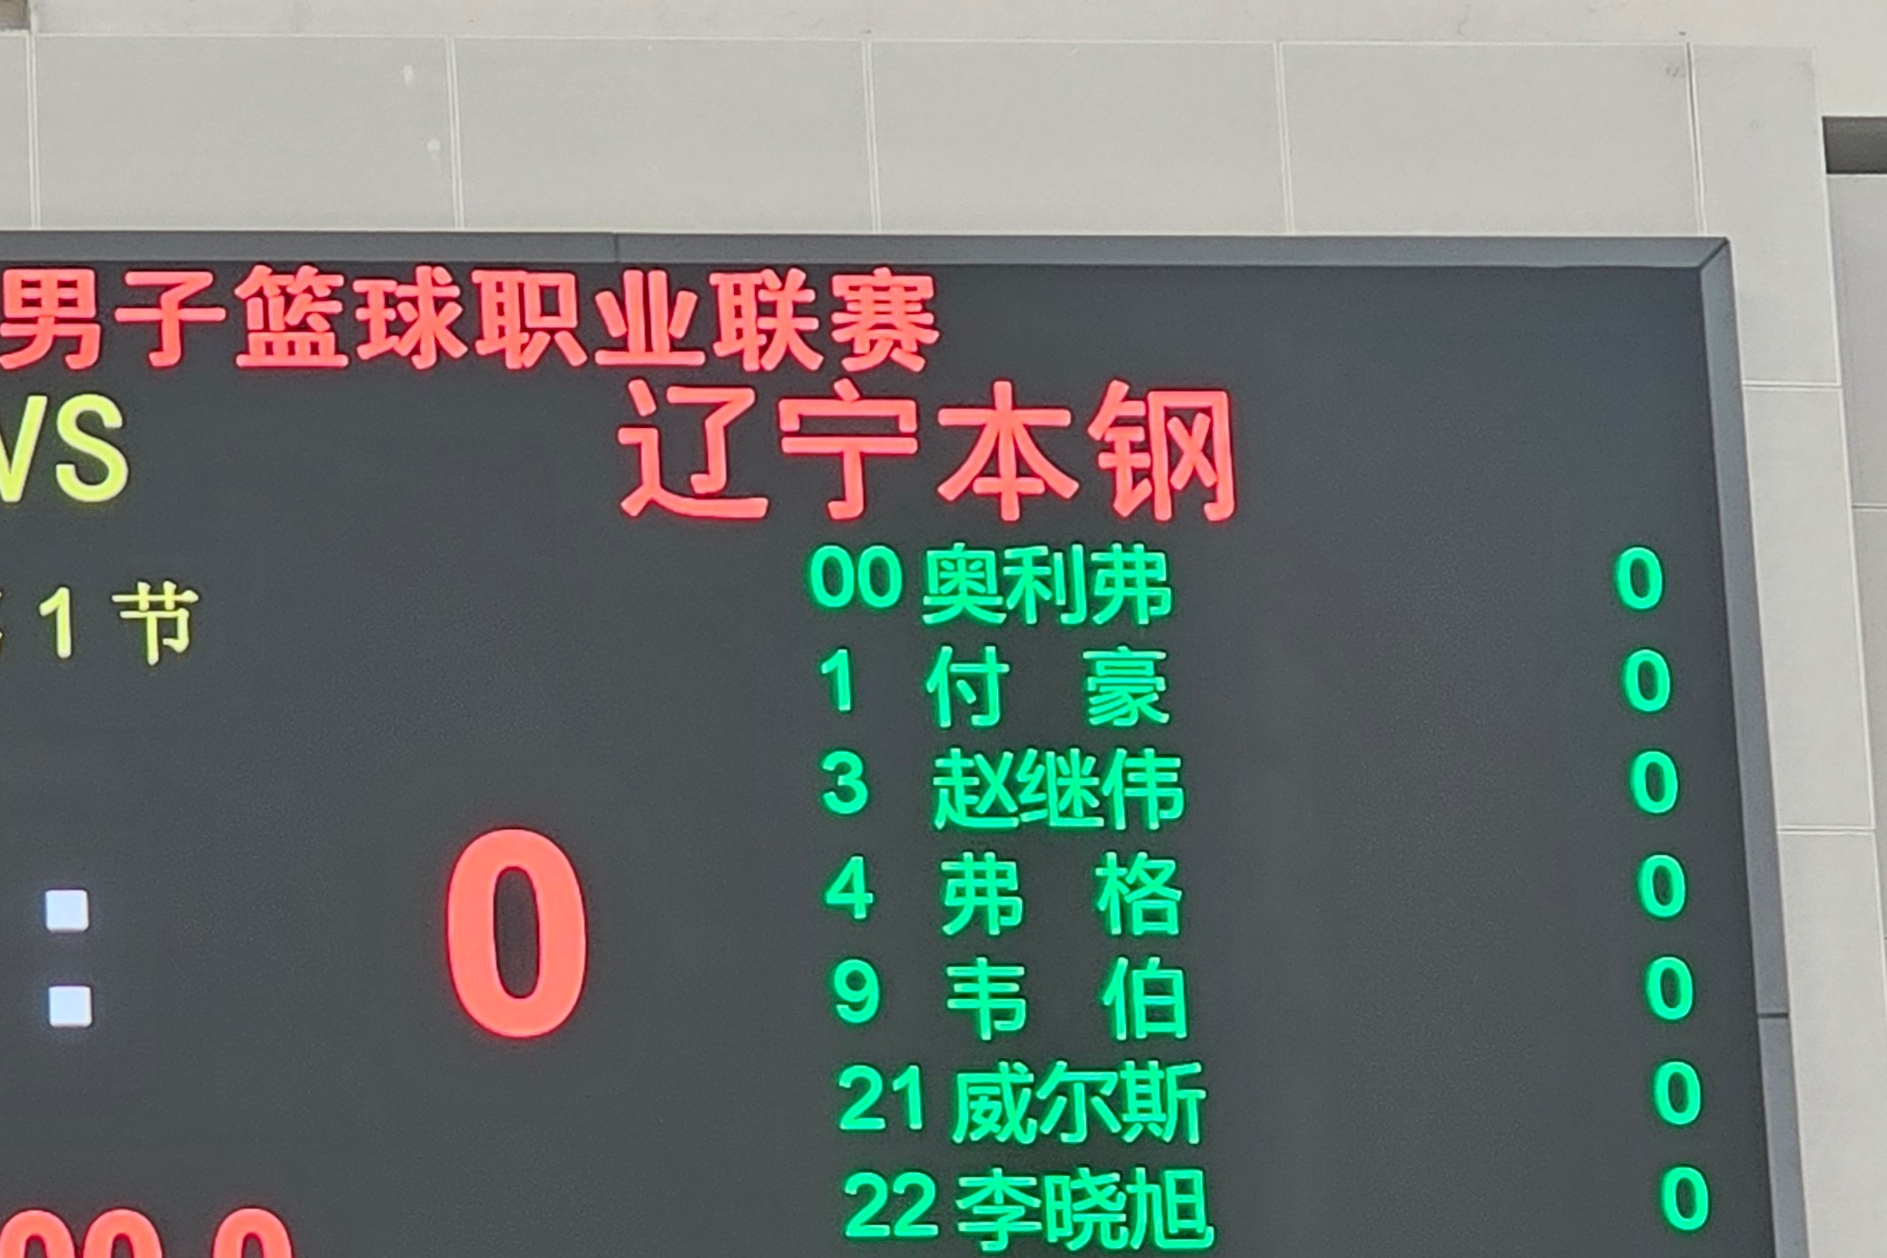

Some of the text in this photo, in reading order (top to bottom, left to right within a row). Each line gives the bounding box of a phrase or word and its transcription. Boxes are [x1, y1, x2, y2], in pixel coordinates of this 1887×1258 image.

[615, 375, 1237, 524] 辽宁本钢
[807, 540, 1665, 627] 00 奥利弗 0
[818, 646, 853, 714] 1
[1621, 647, 1673, 714] 0
[819, 745, 1681, 833] 3 赵继伟 0
[822, 854, 876, 922] 4
[1636, 852, 1688, 920] 0
[444, 827, 589, 1041] 0
[830, 957, 882, 1026] 9
[1644, 954, 1695, 1023] 0
[836, 1058, 1703, 1147] 21 威尔斯 0
[842, 1164, 1711, 1254] 22 李晓旭 0
